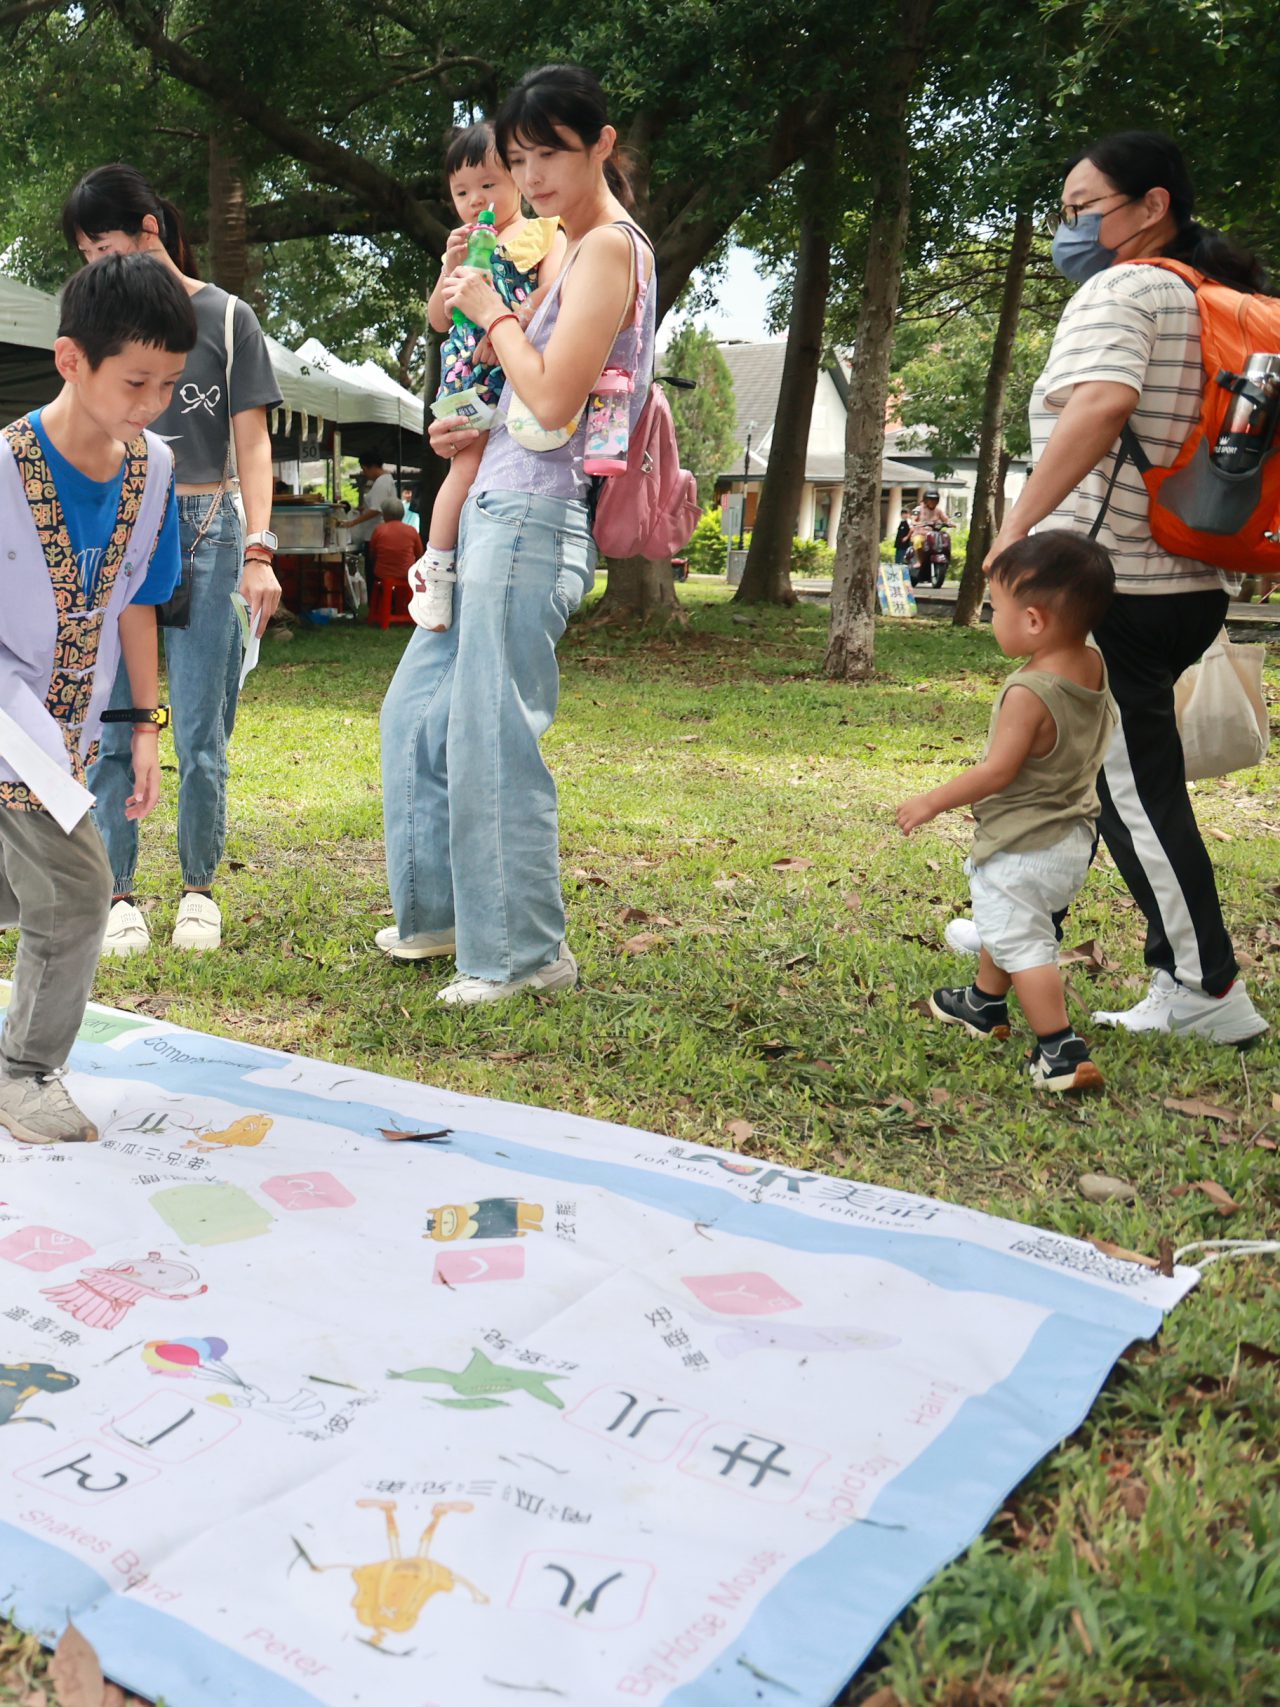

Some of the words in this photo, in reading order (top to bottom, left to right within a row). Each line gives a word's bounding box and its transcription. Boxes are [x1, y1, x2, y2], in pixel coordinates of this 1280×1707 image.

[18, 1506, 113, 1560] Shakes
[658, 1607, 729, 1673] Horse
[708, 1546, 789, 1615] Mouse
[240, 1625, 334, 1678] Peter
